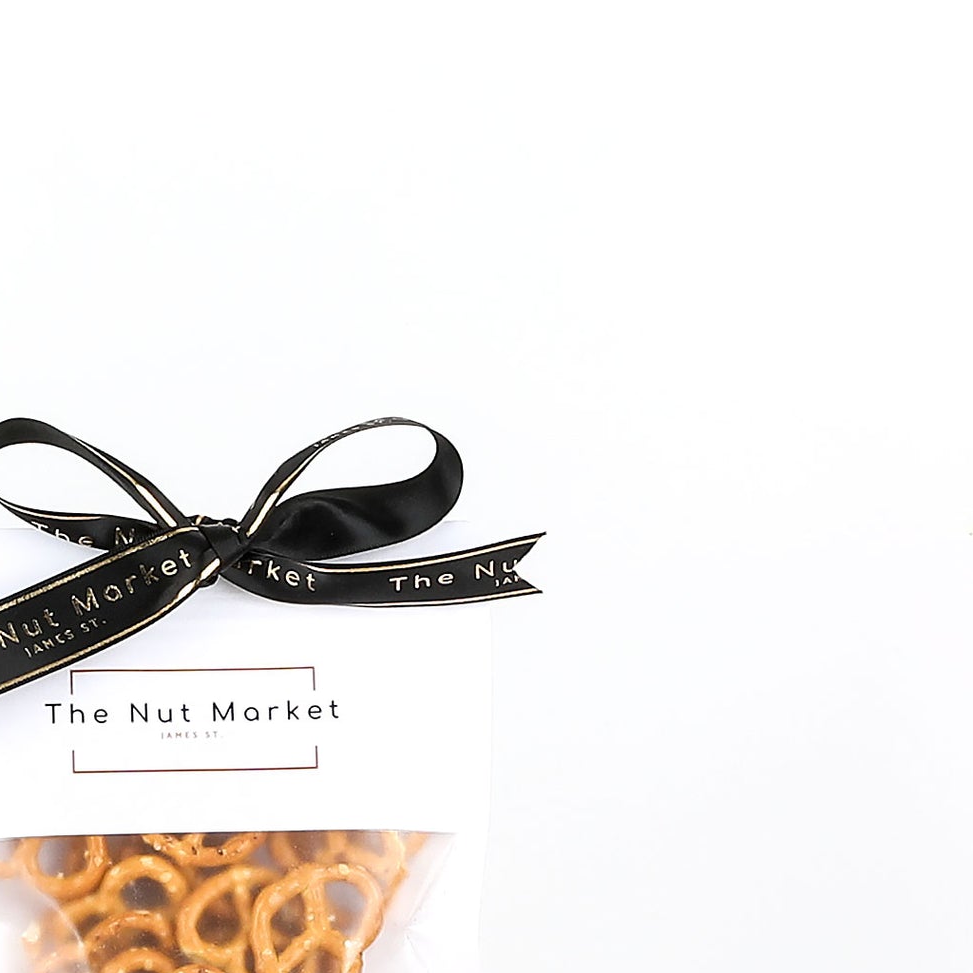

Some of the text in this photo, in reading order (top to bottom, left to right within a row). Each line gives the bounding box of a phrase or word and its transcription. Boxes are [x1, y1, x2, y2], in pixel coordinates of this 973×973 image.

[71, 549, 192, 615] Market
[237, 560, 316, 591] rket
[389, 559, 517, 592] The Nu
[45, 700, 339, 724] The Nut Market
[161, 731, 198, 740] JAMES
